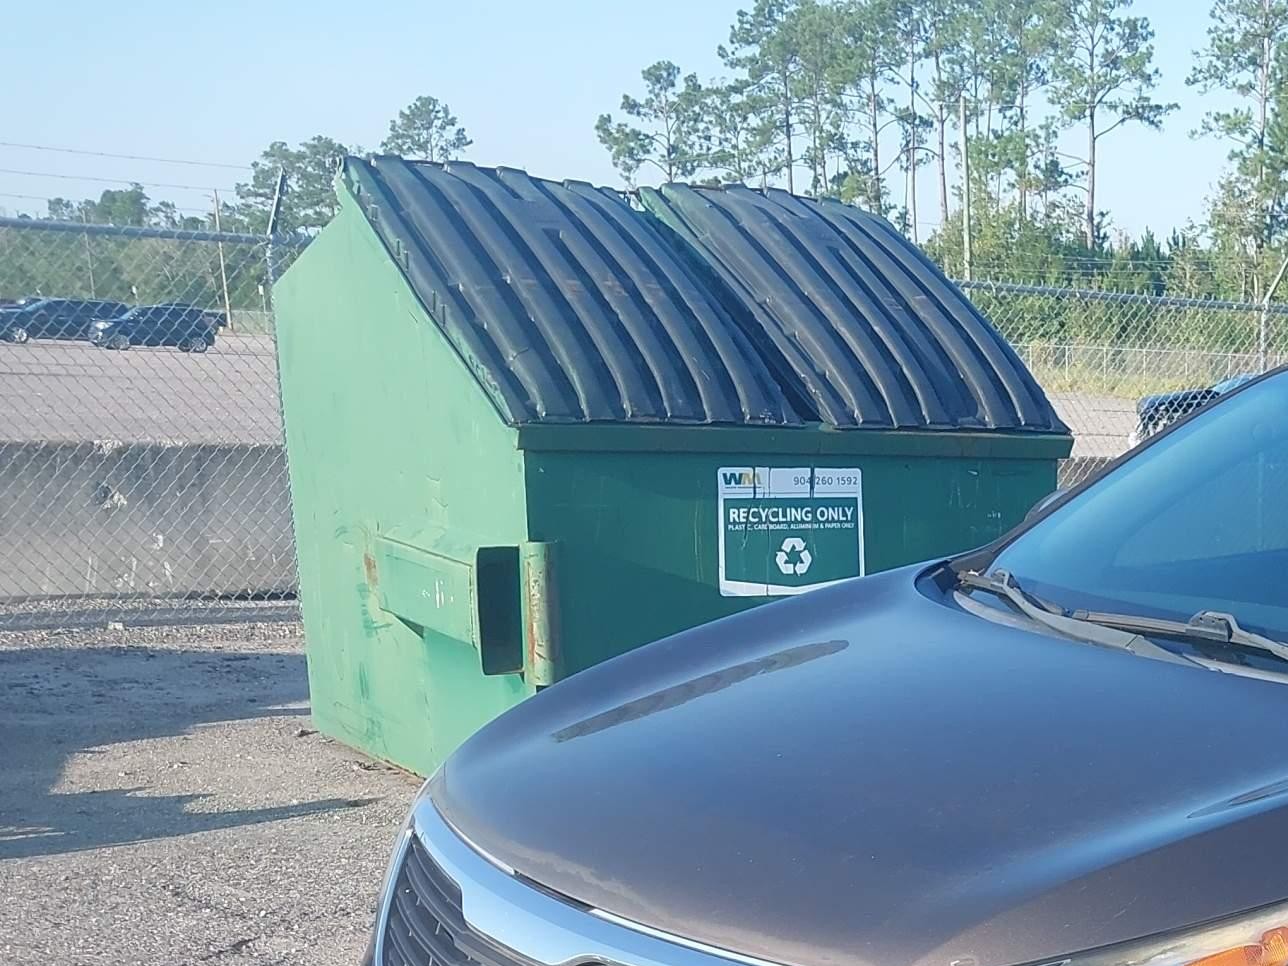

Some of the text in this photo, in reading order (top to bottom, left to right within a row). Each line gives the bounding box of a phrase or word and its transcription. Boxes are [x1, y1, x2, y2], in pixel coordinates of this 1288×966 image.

[722, 472, 761, 485] WM
[816, 476, 833, 486] 260
[836, 476, 858, 486] 1592
[729, 506, 854, 522] RECYCLING ONLY
[728, 523, 753, 531] PLASTC,
